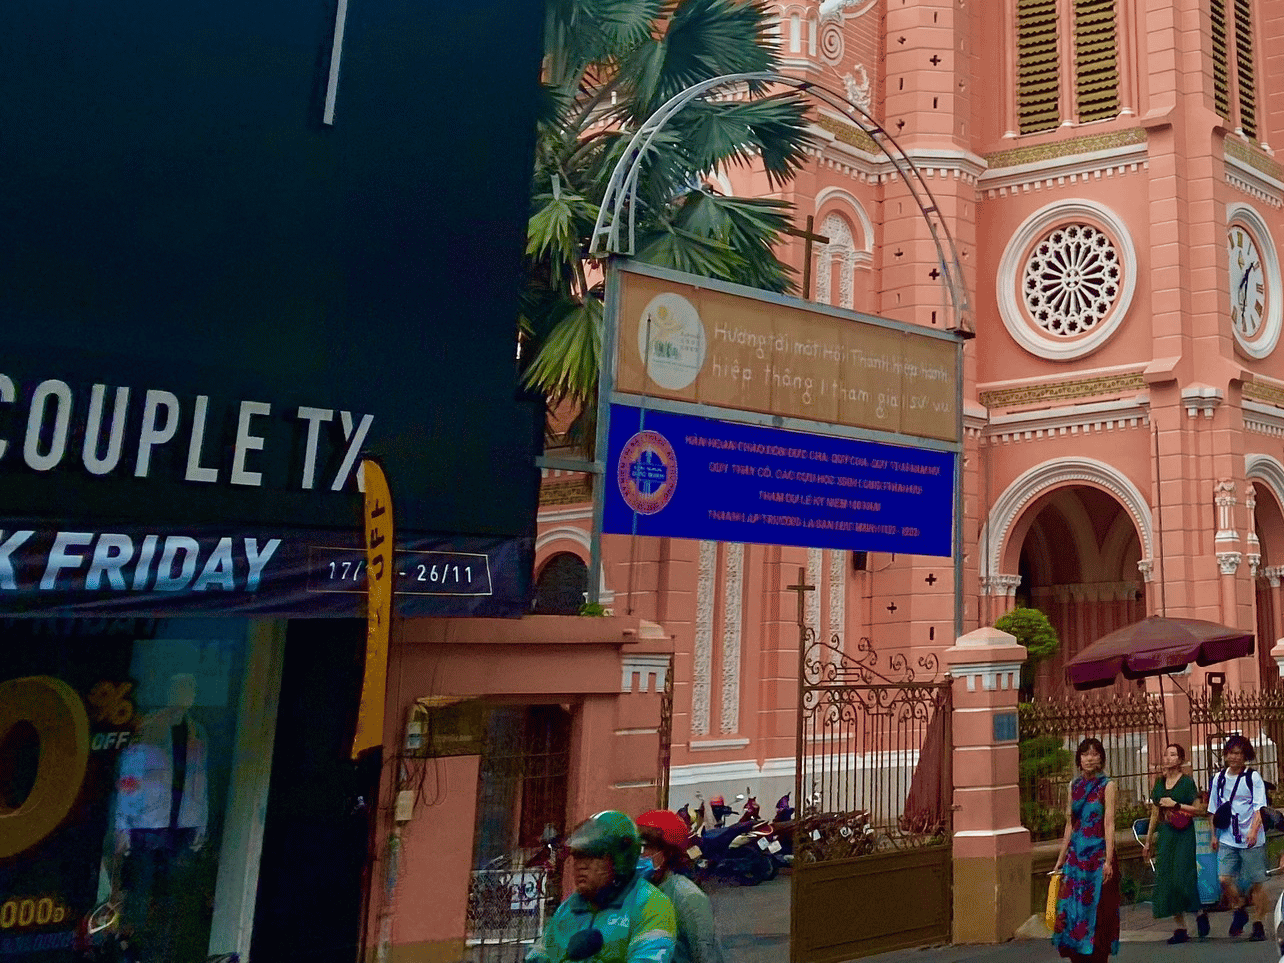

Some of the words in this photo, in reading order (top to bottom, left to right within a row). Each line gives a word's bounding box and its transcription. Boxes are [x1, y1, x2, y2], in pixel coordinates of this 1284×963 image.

[298, 406, 374, 493] TX
[40, 532, 282, 592] FRIDAY
[417, 564, 472, 584] 26/11
